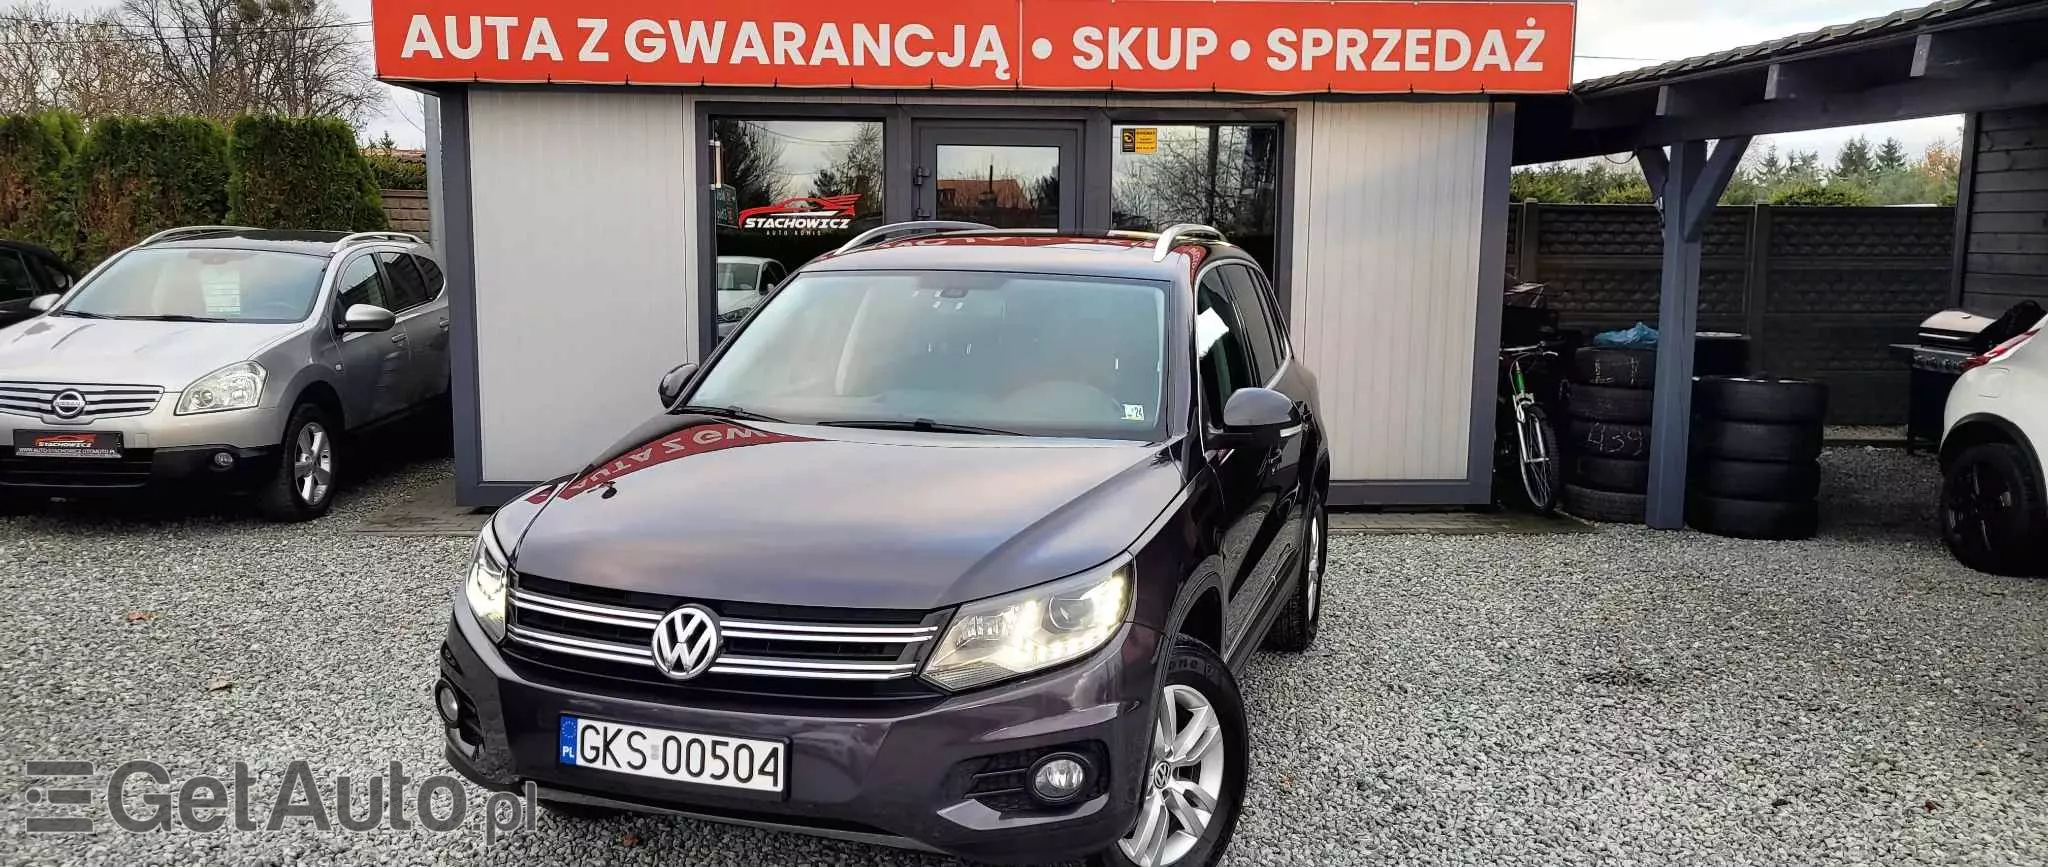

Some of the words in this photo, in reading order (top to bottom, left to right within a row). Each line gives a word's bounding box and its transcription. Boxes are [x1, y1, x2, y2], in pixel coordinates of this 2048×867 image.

[401, 14, 563, 60] AUTA
[577, 17, 609, 62] Z
[624, 19, 1010, 81] GWARANCJĄ
[1072, 26, 1218, 71] SKUP
[1267, 17, 1545, 72] SPRZEDAŻ
[744, 217, 851, 229] STACHOWICZ
[562, 746, 575, 758] PL
[579, 724, 648, 771] GKS
[661, 735, 780, 788] 00504
